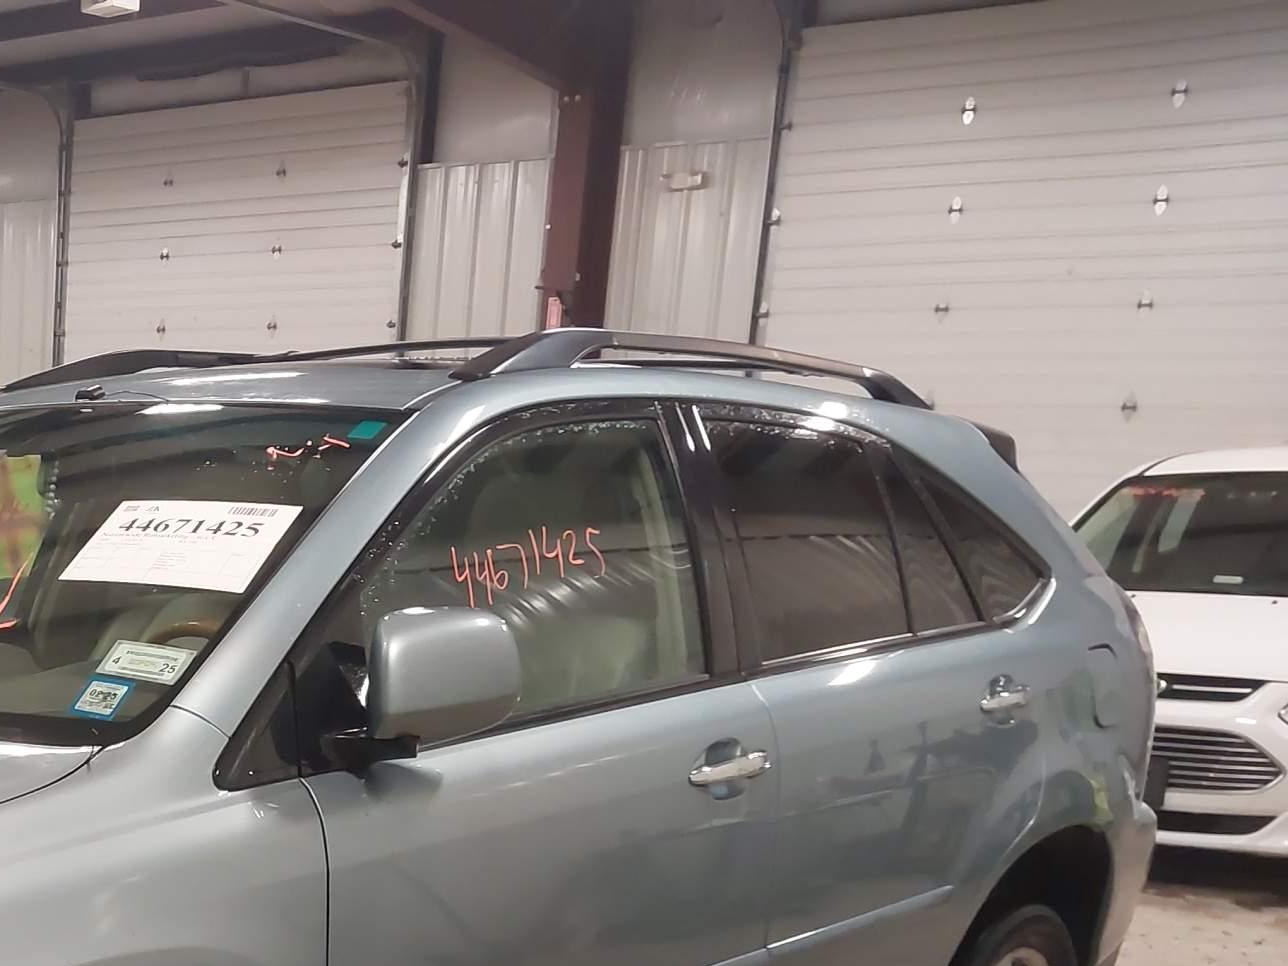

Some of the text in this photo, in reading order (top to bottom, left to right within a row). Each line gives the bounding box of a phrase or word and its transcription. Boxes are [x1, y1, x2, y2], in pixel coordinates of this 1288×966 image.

[118, 517, 266, 538] 44671425
[450, 526, 606, 608] 44671425
[158, 662, 177, 674] 25
